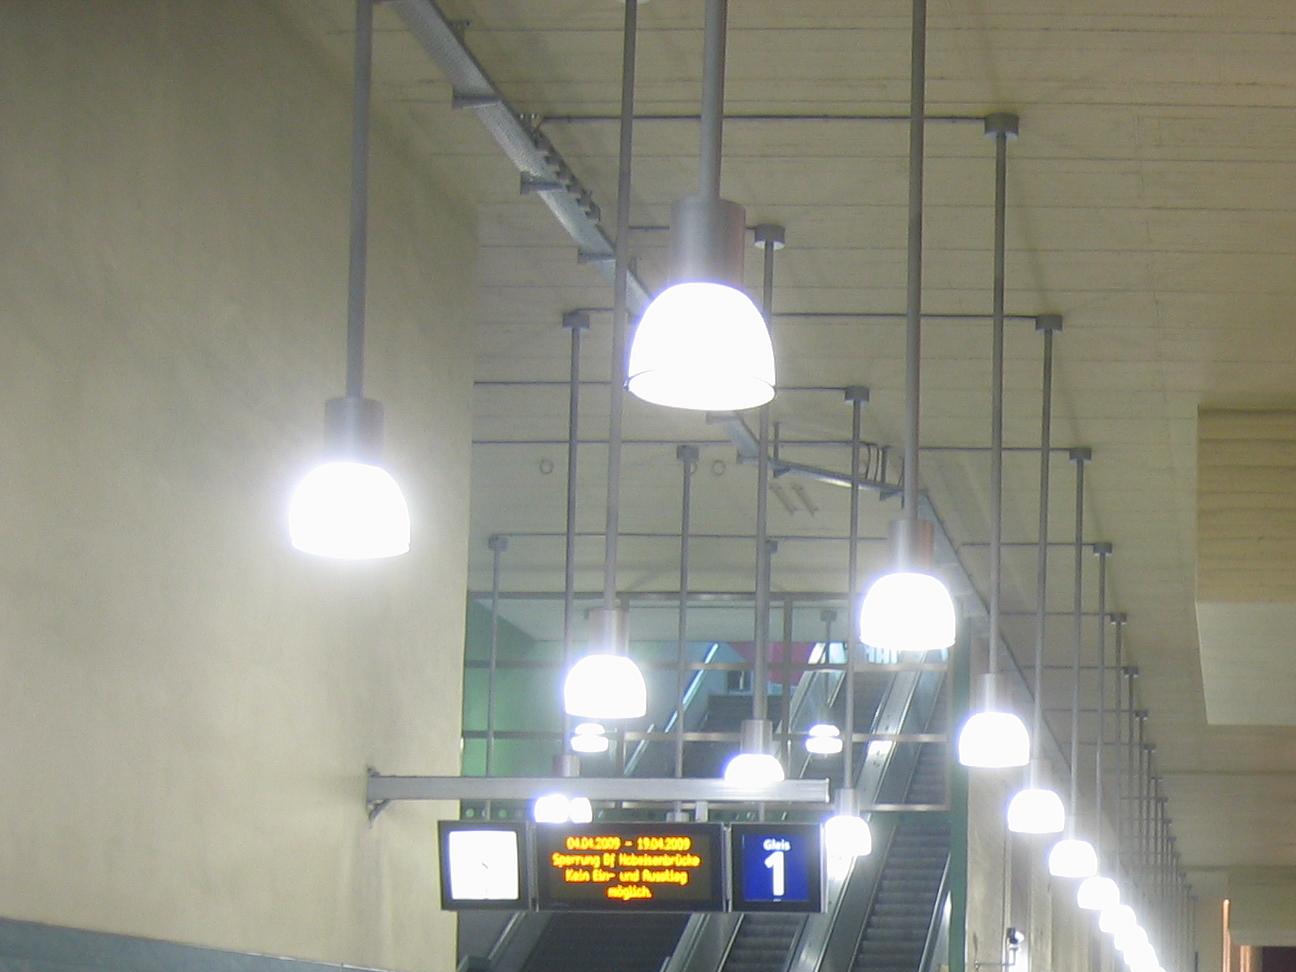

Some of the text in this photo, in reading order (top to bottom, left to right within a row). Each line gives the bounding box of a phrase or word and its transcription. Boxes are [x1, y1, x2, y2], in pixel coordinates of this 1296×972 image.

[566, 836, 621, 850] 04.04.2009
[763, 838, 791, 851] Gleis
[552, 852, 600, 868] Sperrung
[565, 868, 590, 882] Kein
[619, 869, 640, 882] und
[642, 868, 688, 885] Ausstieg
[764, 850, 785, 896] 1
[607, 884, 652, 900] möglich.
